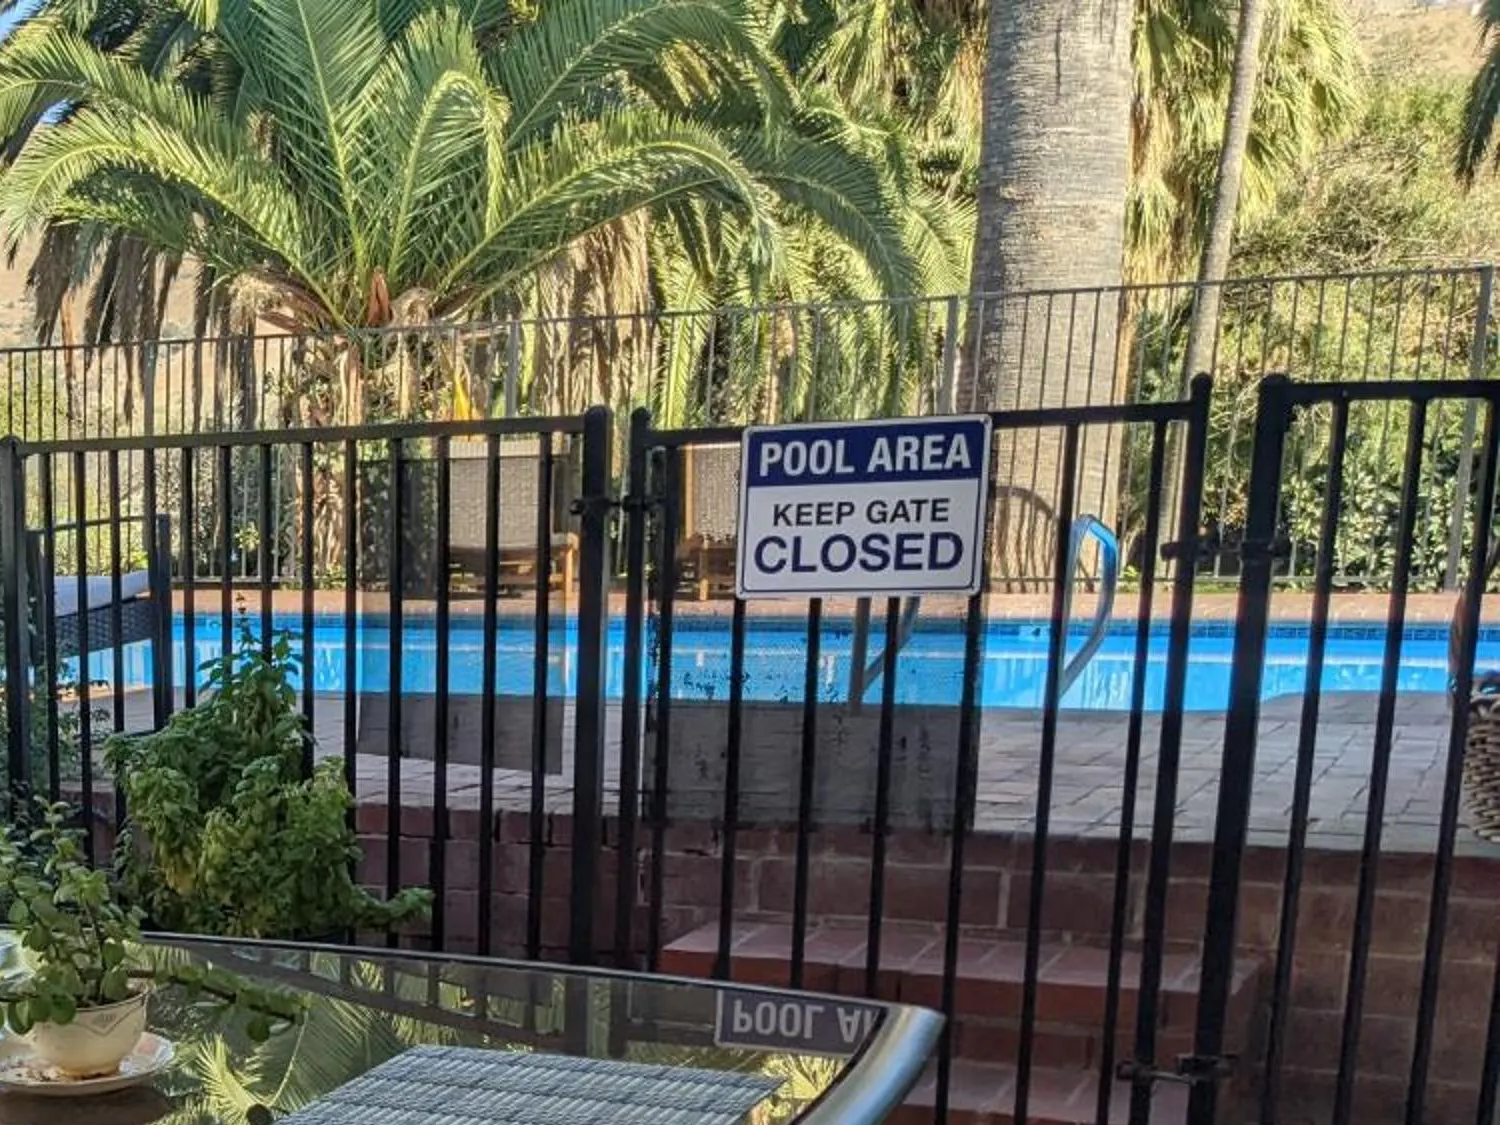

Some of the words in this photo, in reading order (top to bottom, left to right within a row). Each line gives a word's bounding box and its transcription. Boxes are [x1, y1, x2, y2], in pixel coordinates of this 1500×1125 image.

[759, 439, 855, 477] POOL
[867, 433, 971, 473] AREA
[772, 501, 855, 527] KEEP
[866, 498, 950, 524] GATE
[754, 531, 963, 574] CLOSED
